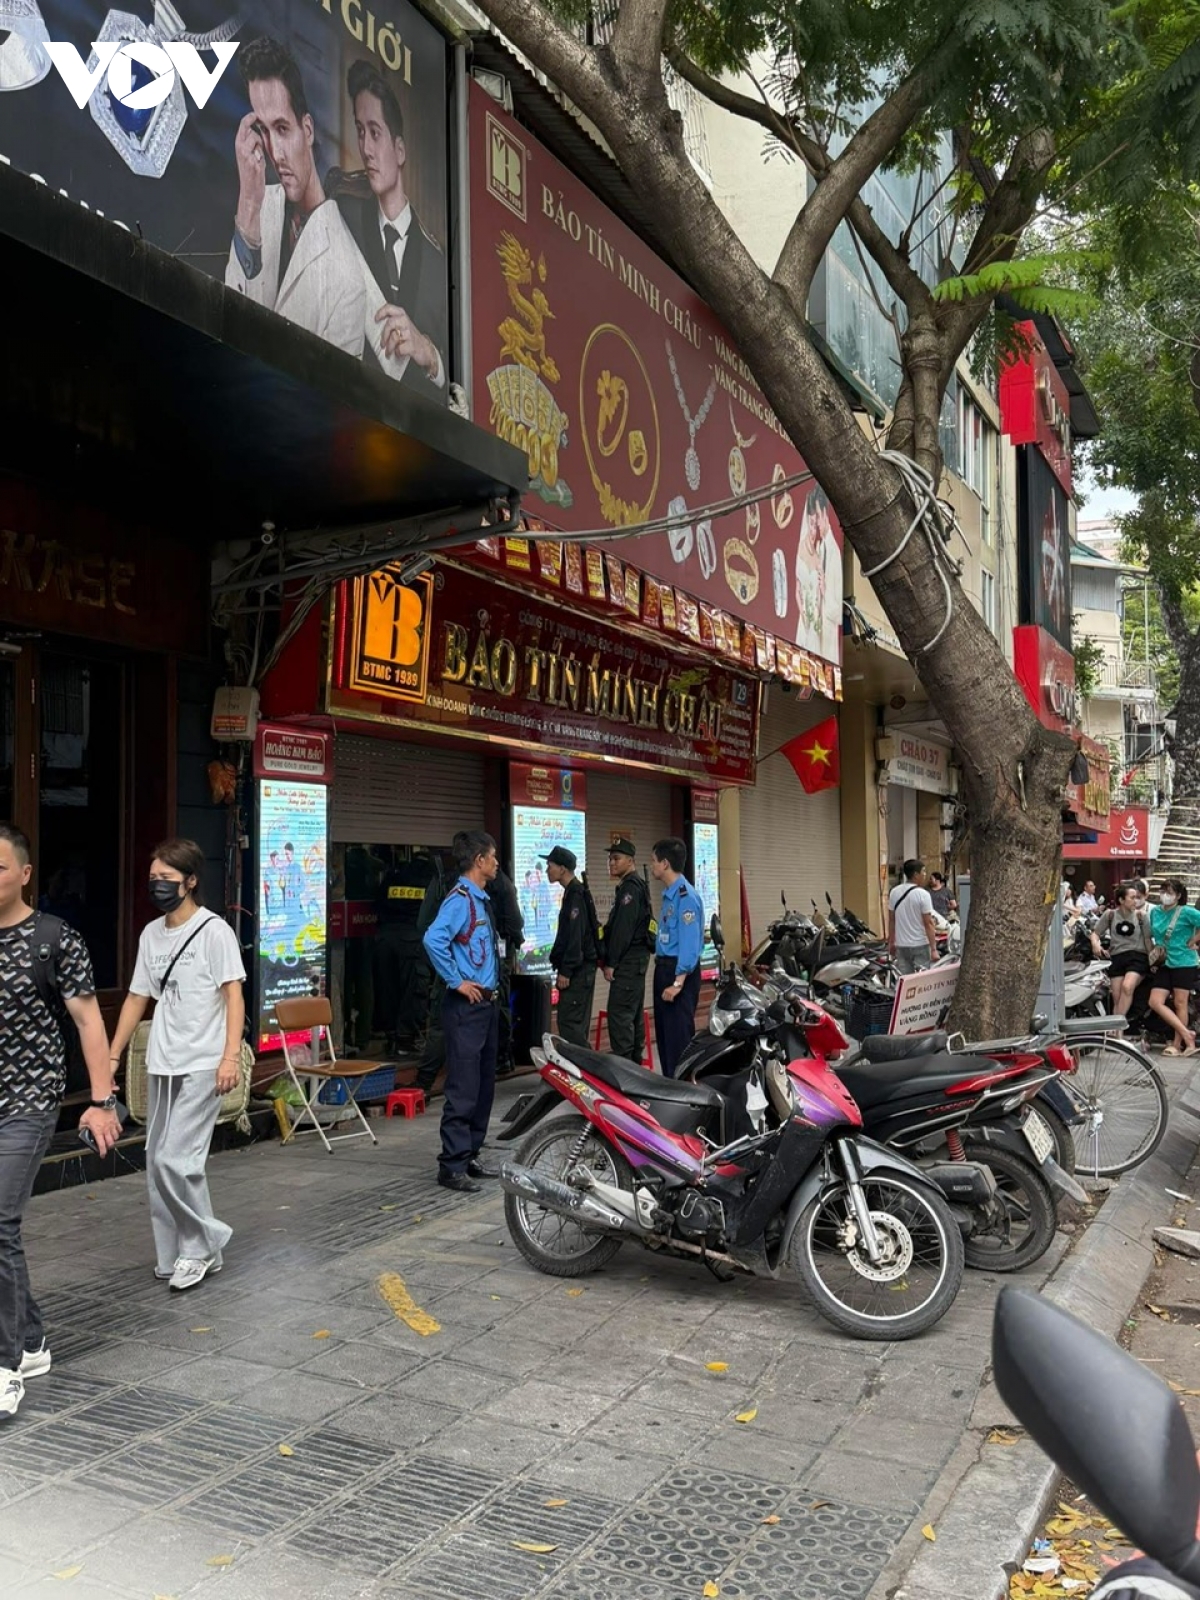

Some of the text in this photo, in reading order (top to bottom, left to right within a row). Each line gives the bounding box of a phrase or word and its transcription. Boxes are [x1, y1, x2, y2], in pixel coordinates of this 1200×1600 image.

[541, 184, 702, 350] BẢO TÍN MINH CHÂU
[714, 364, 738, 399] VÀNG
[738, 384, 764, 421] TRANG
[363, 660, 419, 687] BTMC 1989
[440, 608, 517, 697] BẢO
[525, 637, 582, 712] TÍN
[583, 662, 660, 731] MINH
[662, 685, 722, 745] CHÂU
[737, 682, 747, 701] 29
[426, 694, 444, 710] KINH
[443, 698, 468, 715] DOANH
[270, 759, 283, 768] PURE
[929, 749, 940, 766] 37
